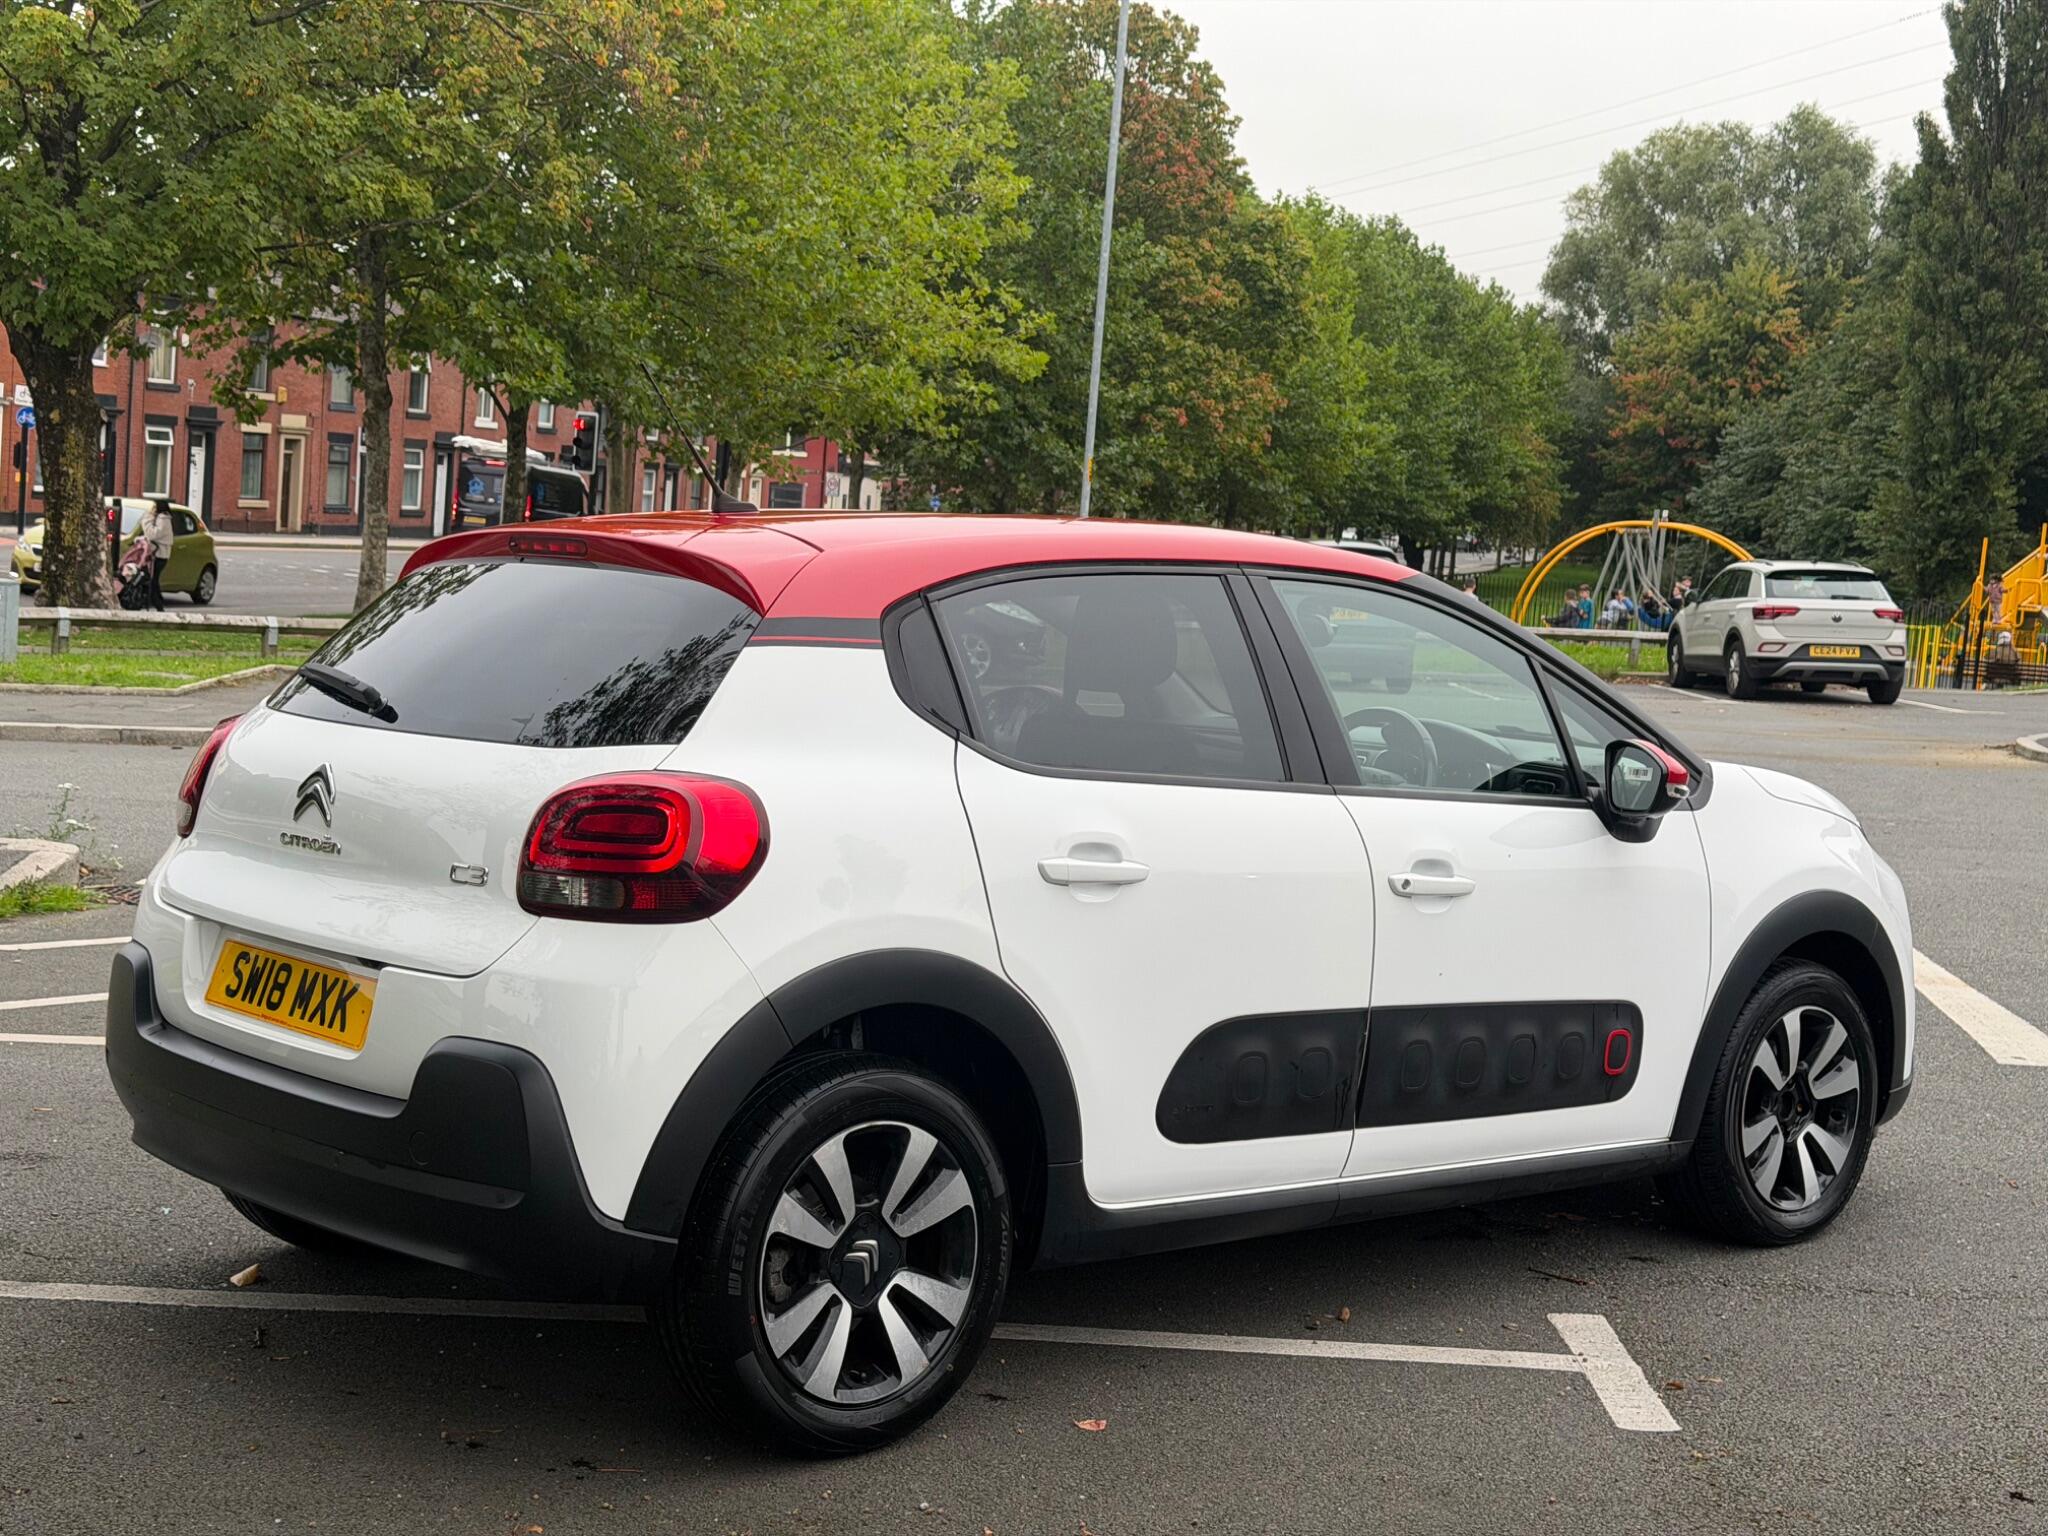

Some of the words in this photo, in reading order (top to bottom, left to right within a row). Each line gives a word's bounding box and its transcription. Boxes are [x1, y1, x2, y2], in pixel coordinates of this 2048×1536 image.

[449, 863, 488, 887] C3
[225, 951, 293, 1012] SW18
[288, 968, 361, 1033] MXK
